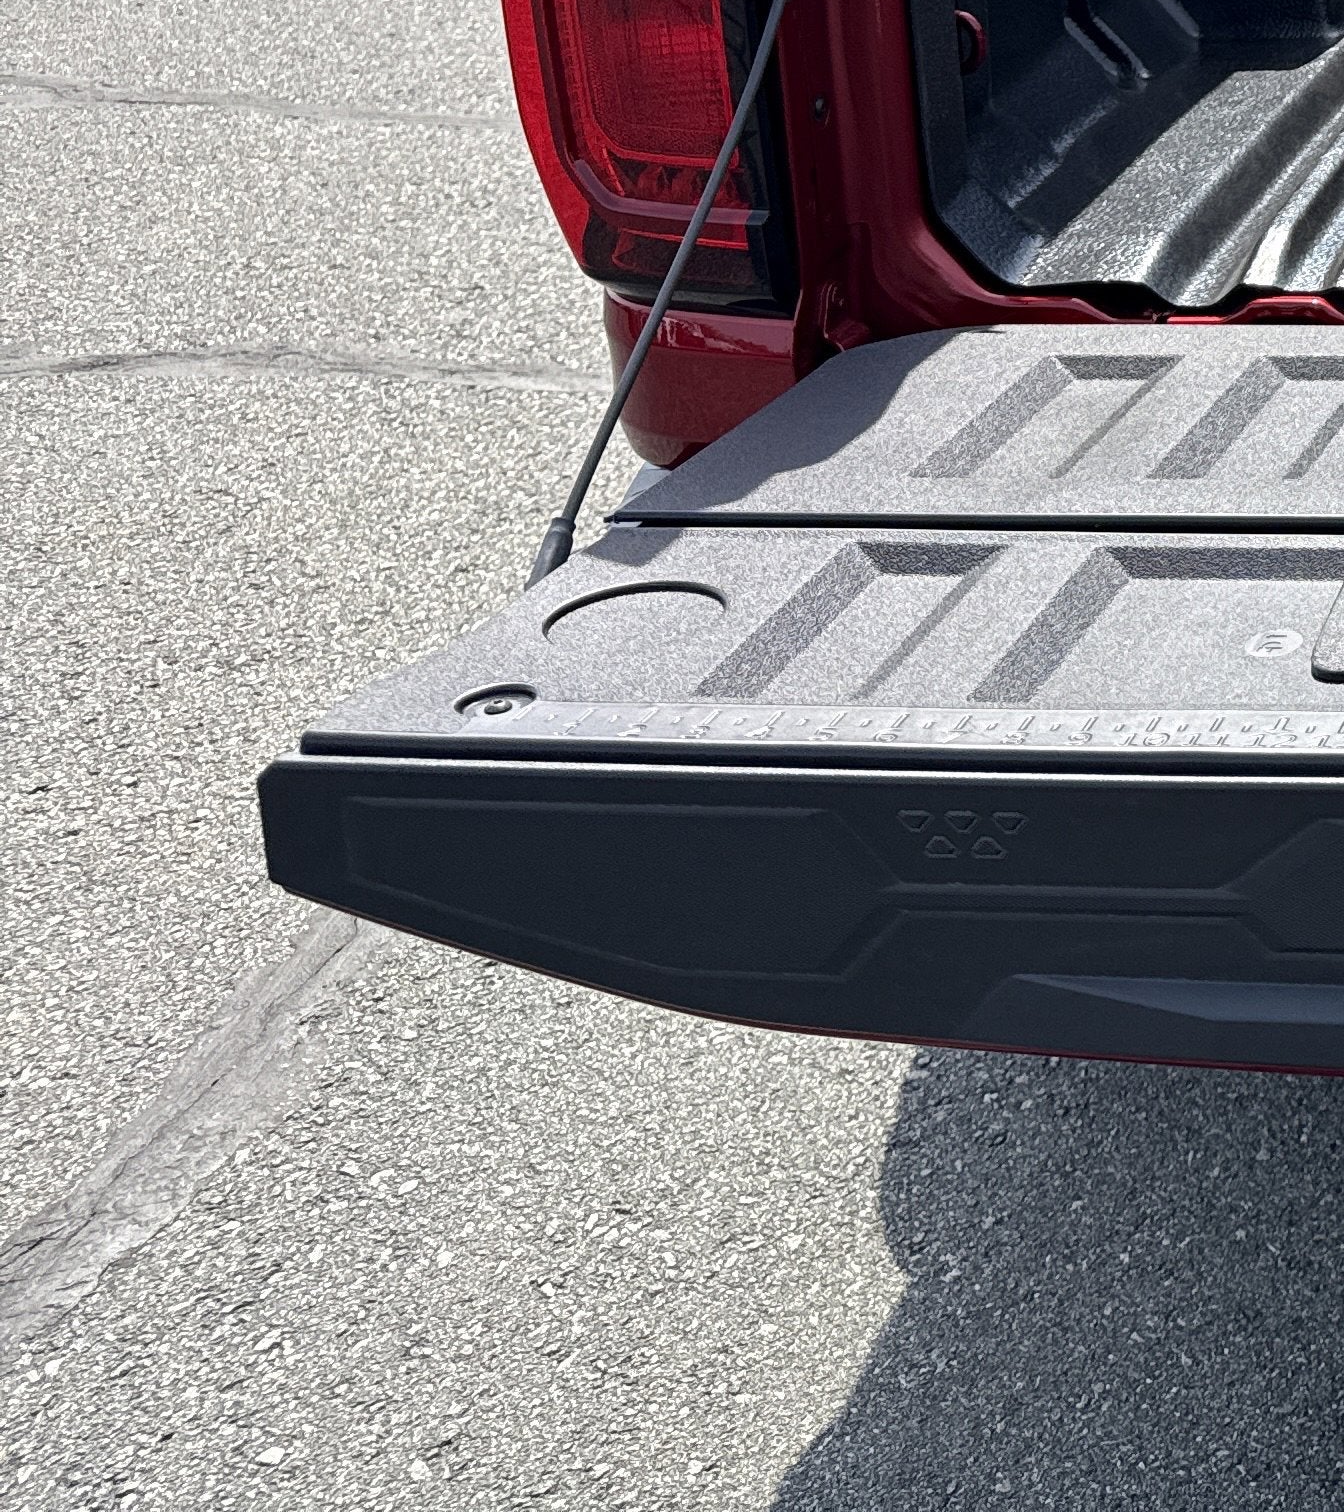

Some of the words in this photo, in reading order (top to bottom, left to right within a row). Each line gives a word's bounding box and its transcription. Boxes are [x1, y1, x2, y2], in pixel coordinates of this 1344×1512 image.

[744, 725, 774, 739] 4
[809, 728, 837, 741] 5
[874, 729, 902, 742] 6
[1000, 732, 1029, 744] 8
[1066, 732, 1093, 746] 9
[1118, 733, 1170, 747] 10
[1182, 733, 1230, 747] 11
[1246, 734, 1298, 748] 12
